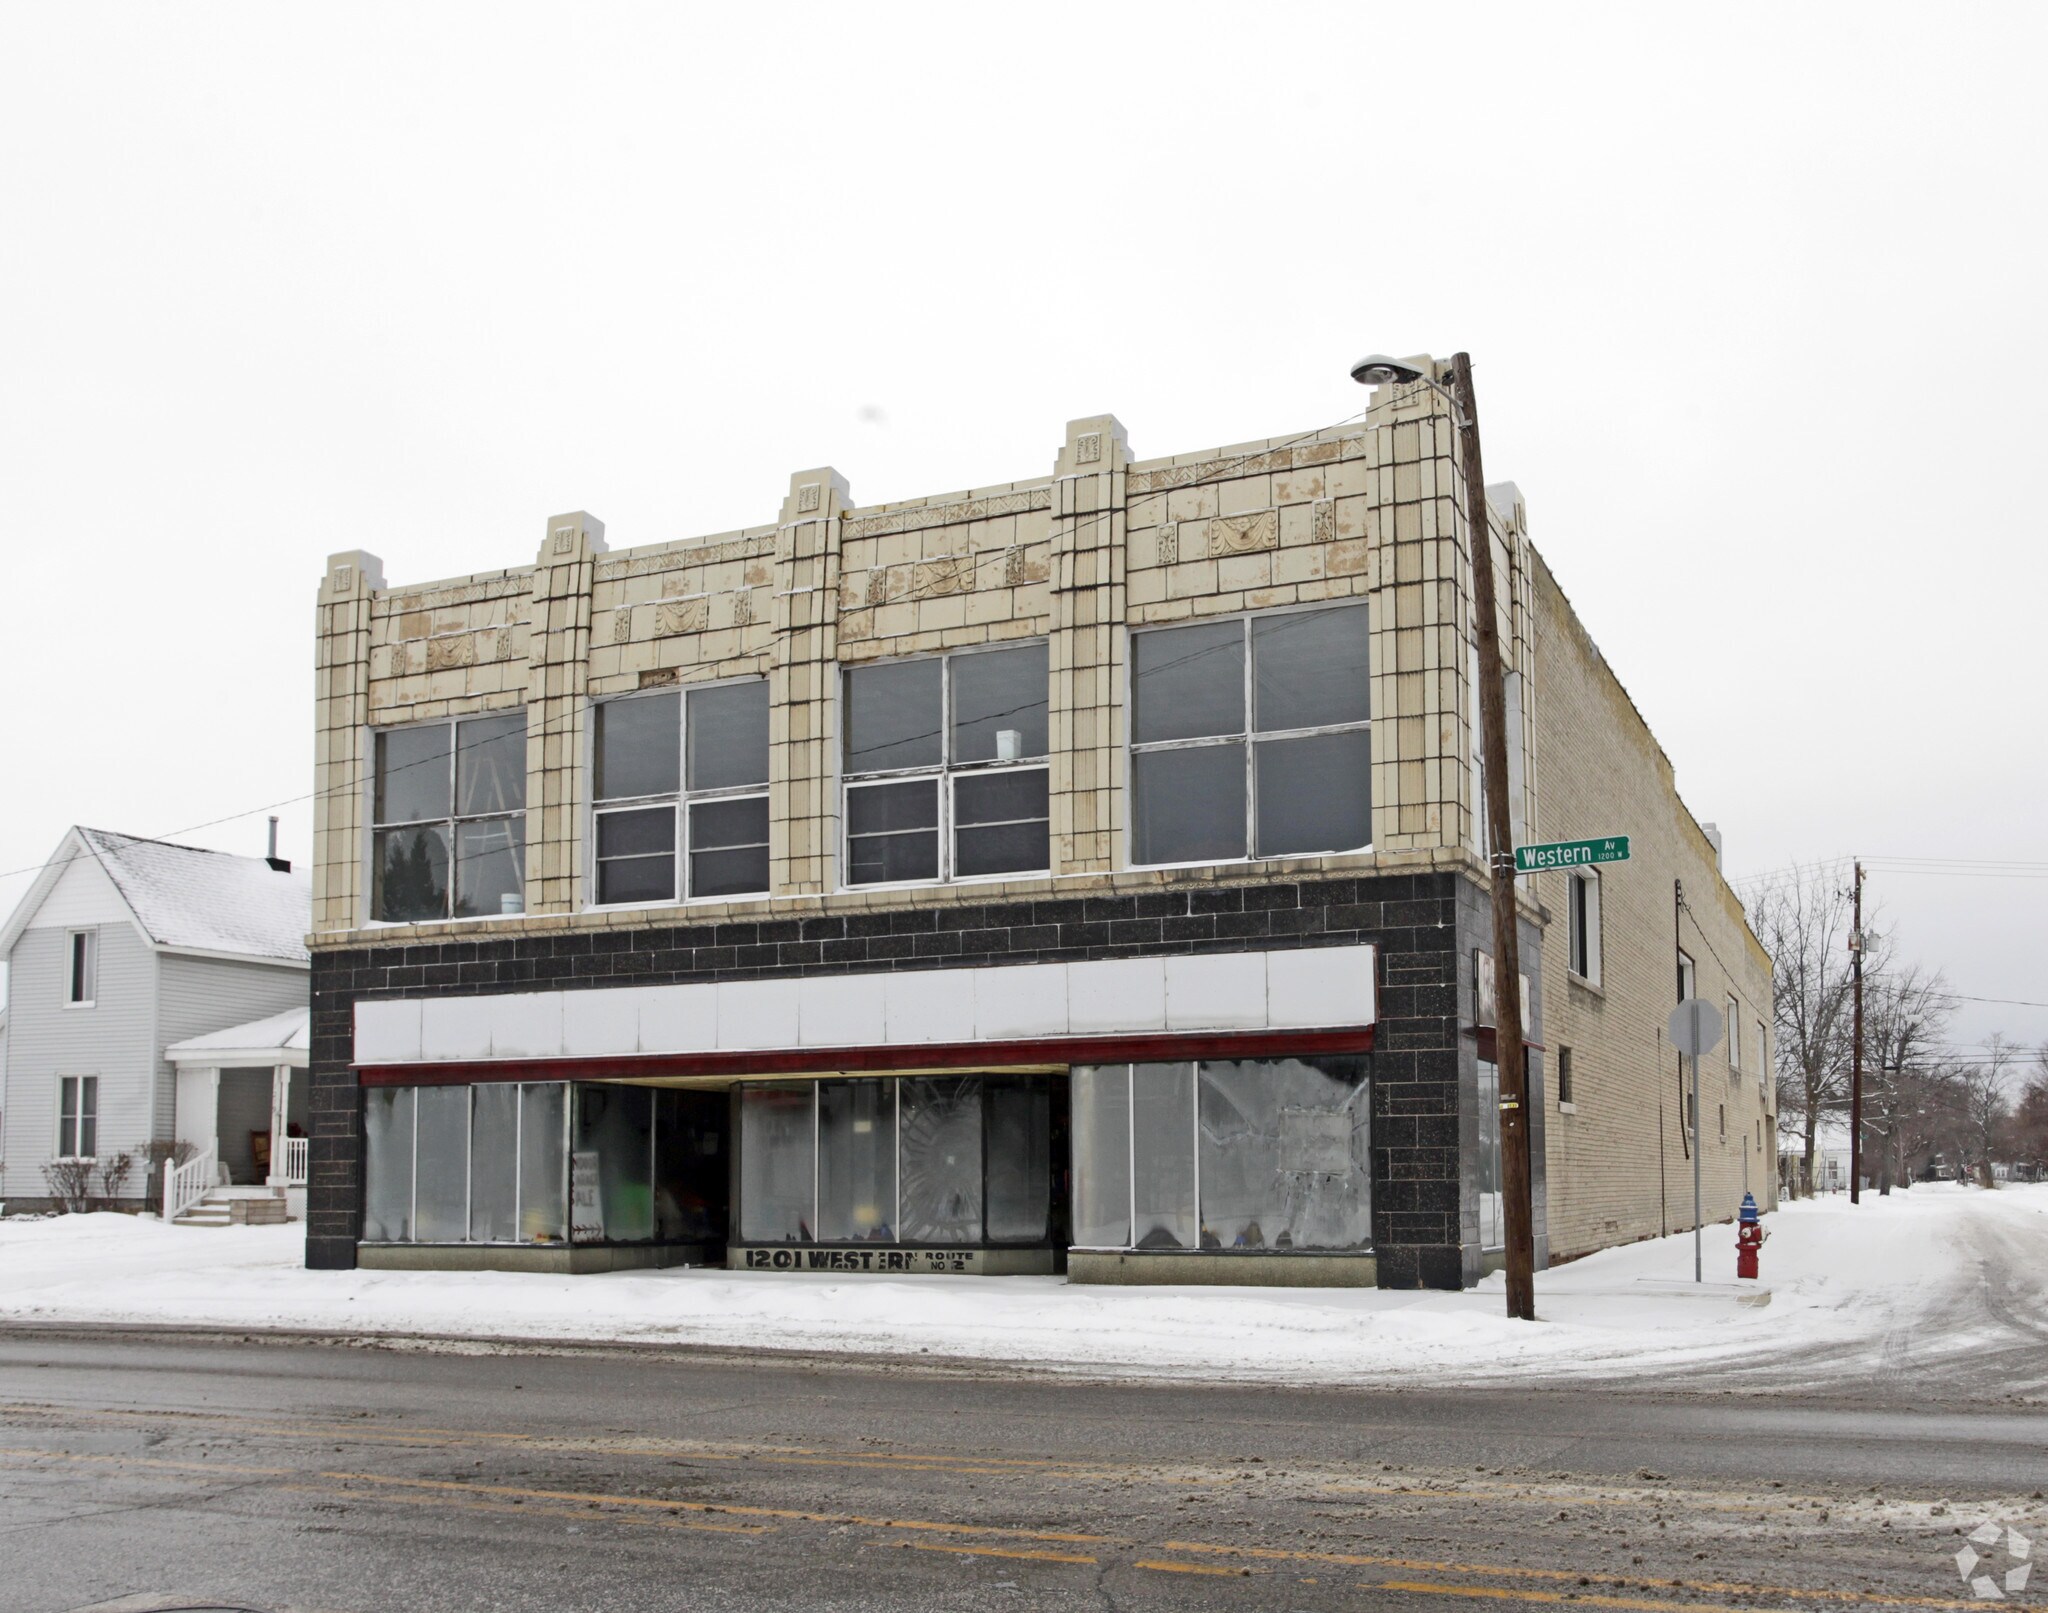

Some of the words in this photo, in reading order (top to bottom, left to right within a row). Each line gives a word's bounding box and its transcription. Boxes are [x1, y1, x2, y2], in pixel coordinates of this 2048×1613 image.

[1604, 841, 1615, 850] Av
[1522, 846, 1591, 867] Western
[746, 1250, 802, 1268] 1201
[925, 1252, 973, 1260] ROUTE
